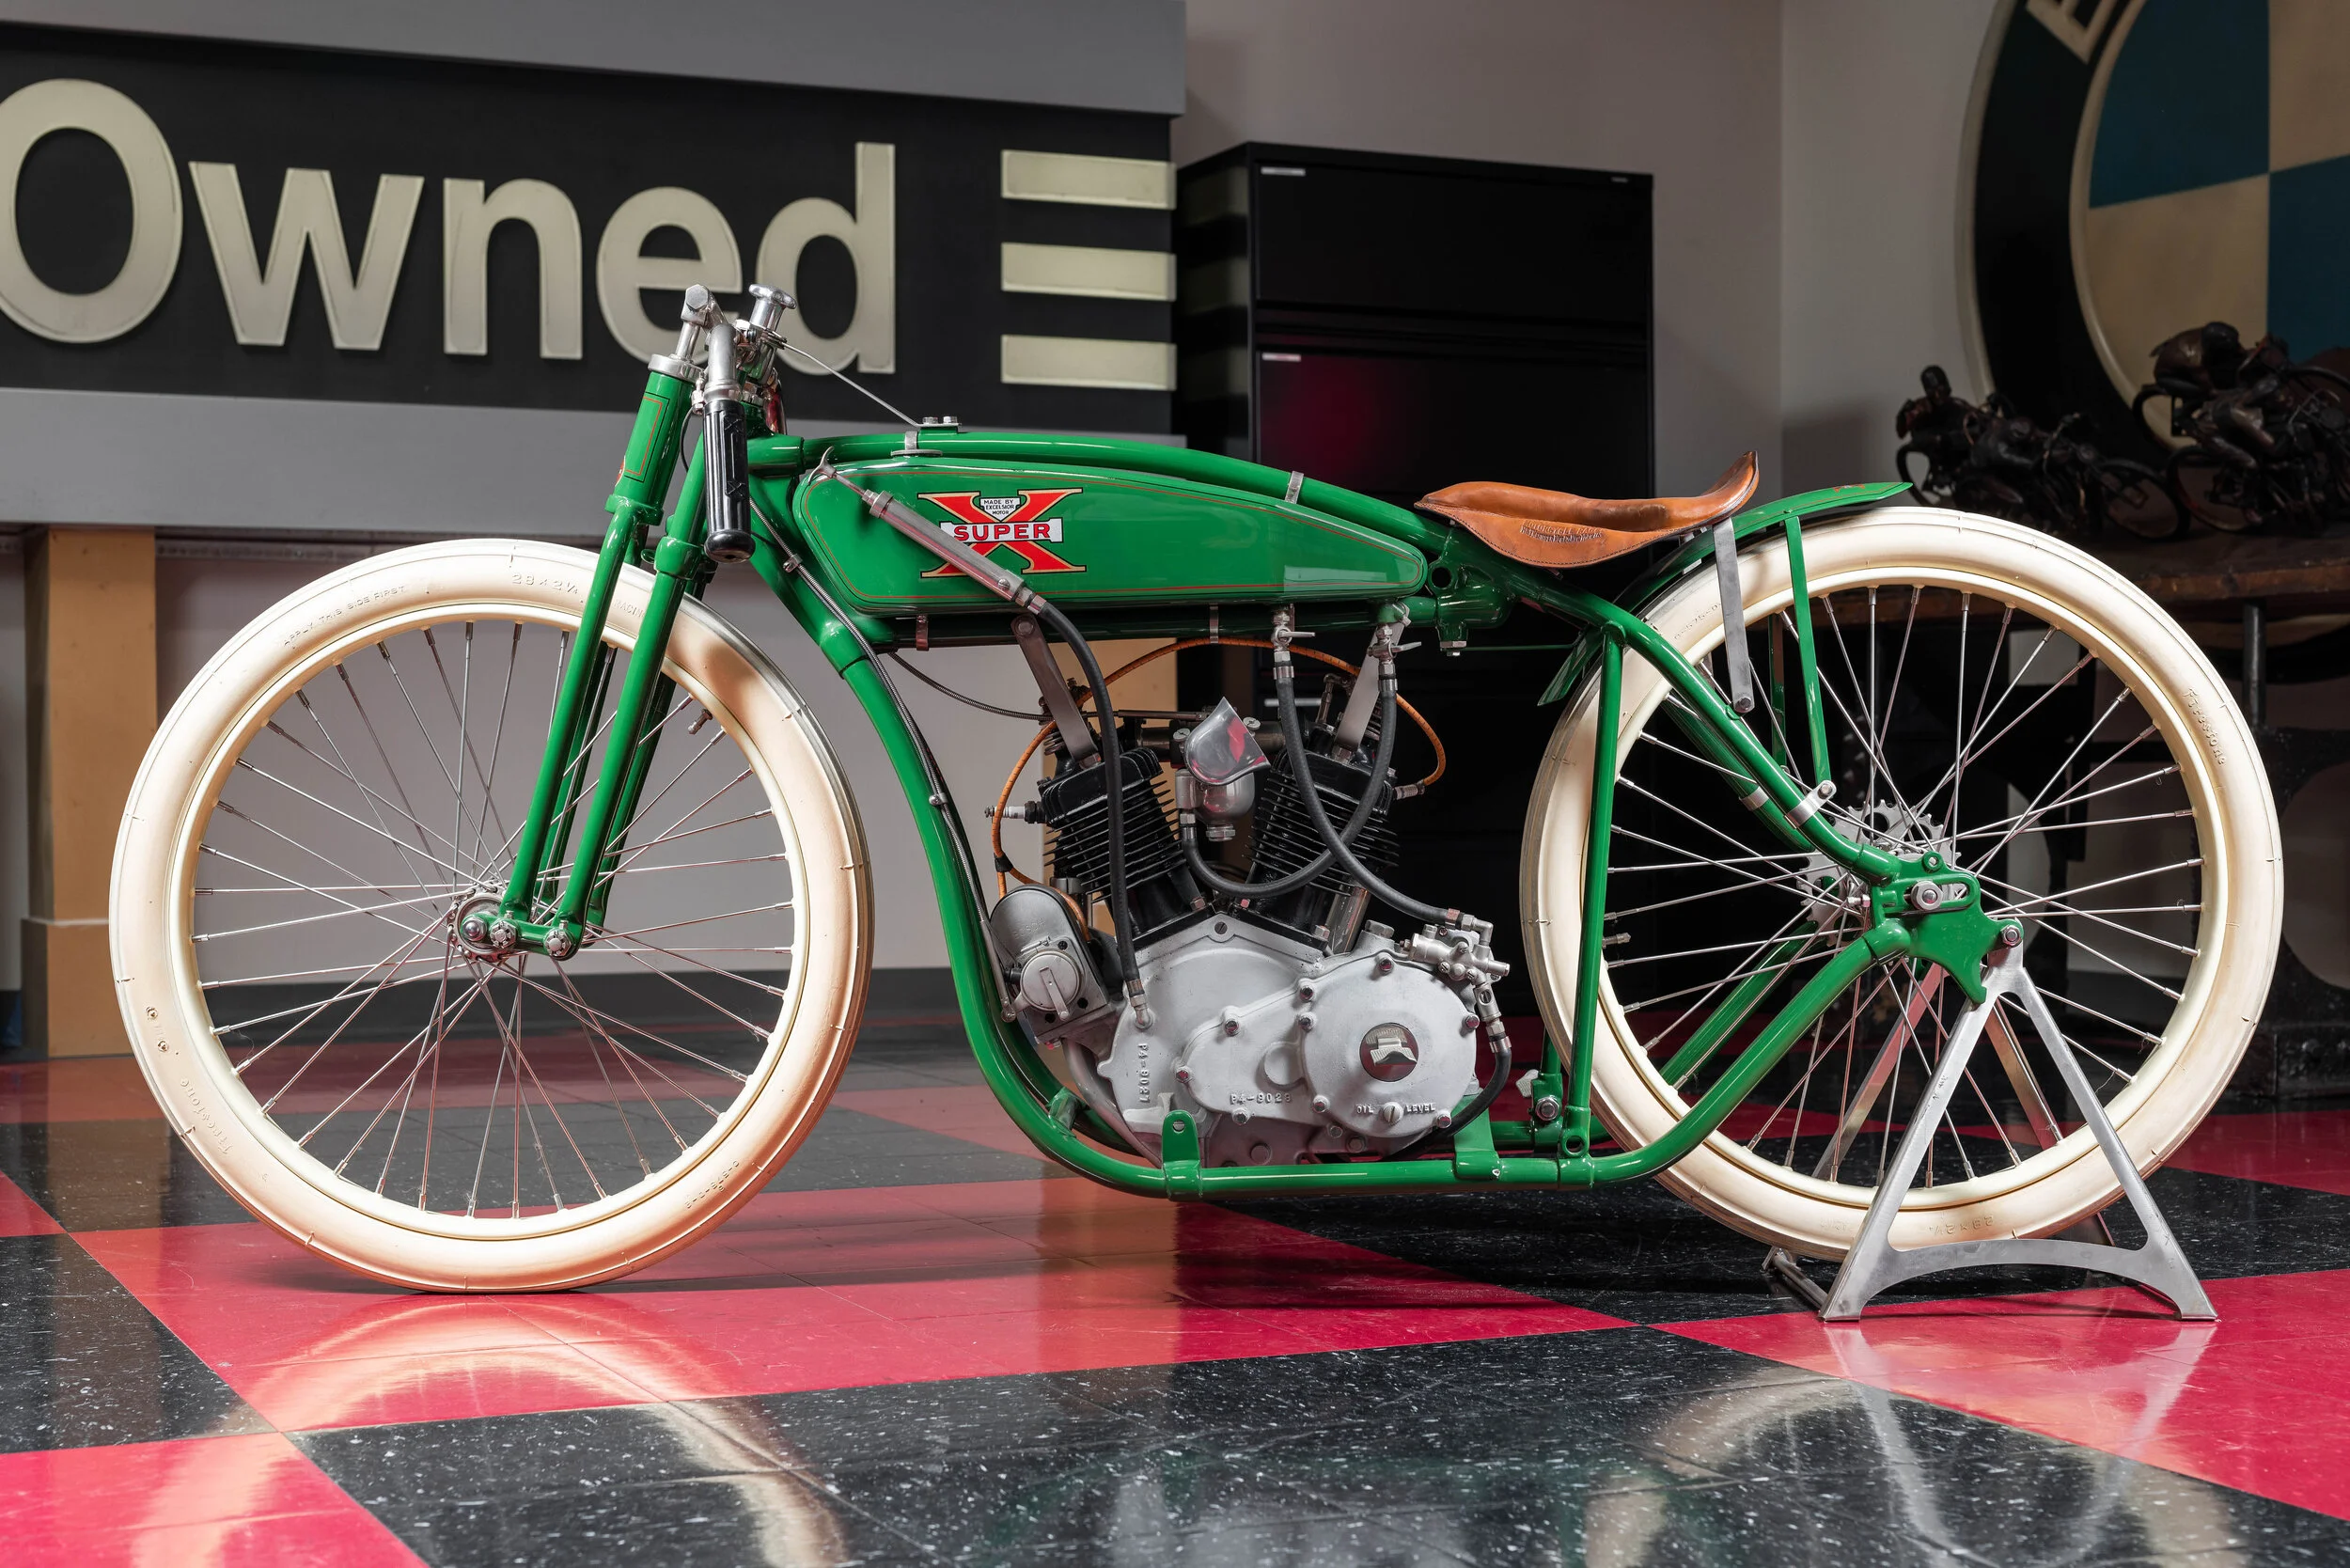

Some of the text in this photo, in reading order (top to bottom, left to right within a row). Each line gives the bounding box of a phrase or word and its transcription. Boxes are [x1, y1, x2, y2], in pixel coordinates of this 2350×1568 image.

[0, 78, 896, 374] Owned
[953, 523, 1051, 541] SUPER
[613, 599, 646, 619] RACIN
[1356, 1102, 1437, 1114] OIL LEVEL
